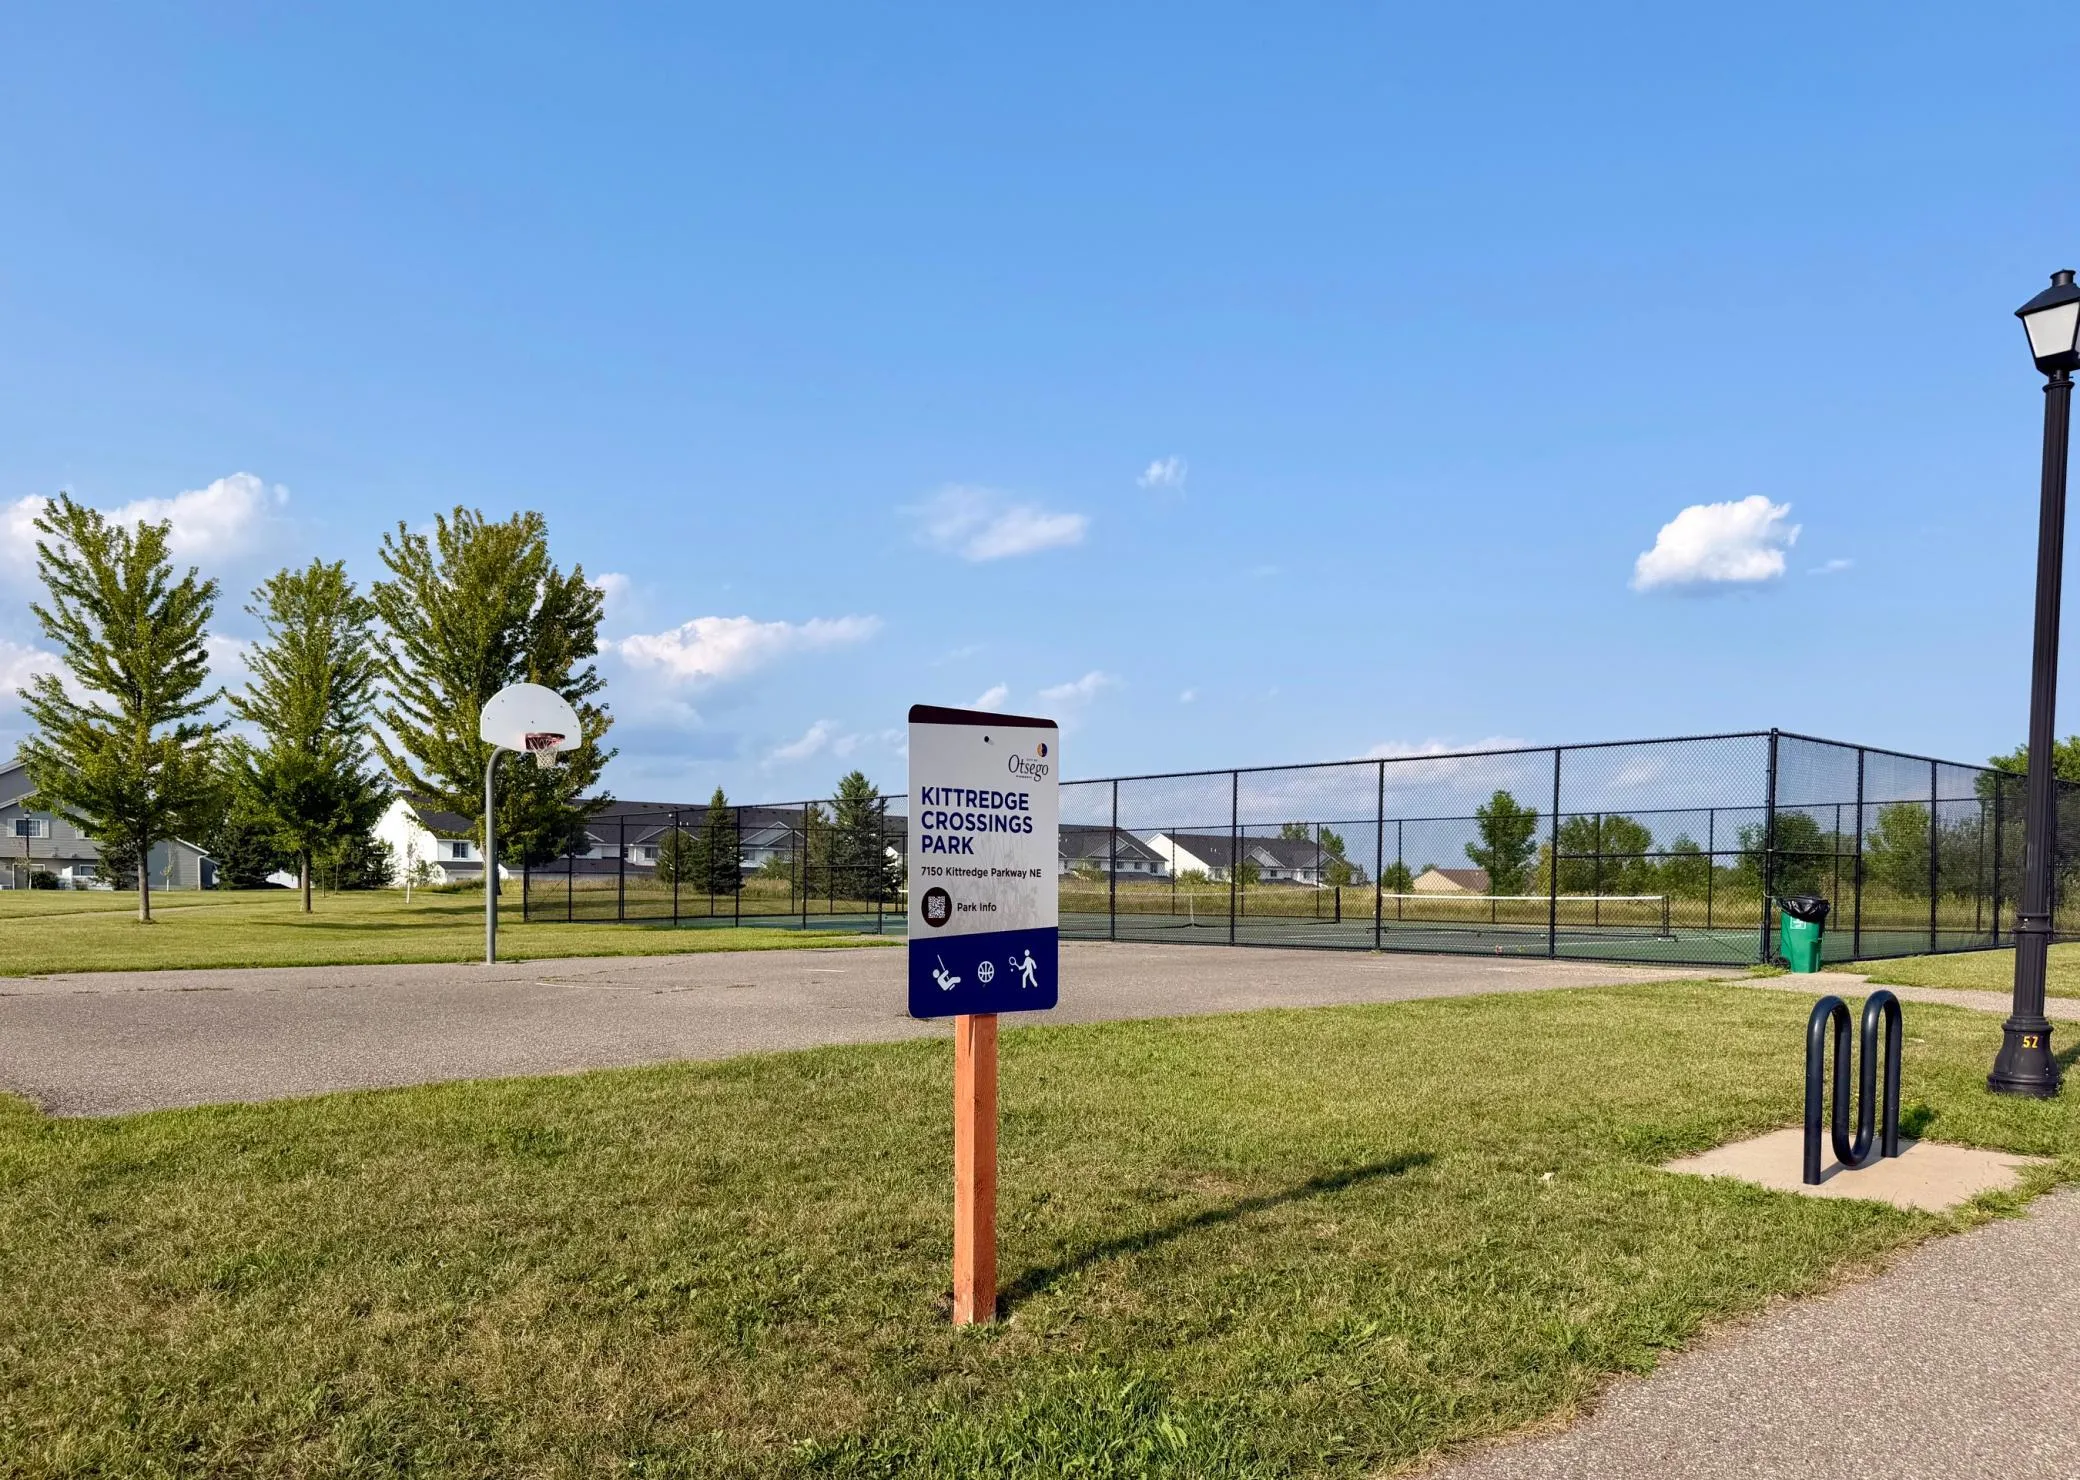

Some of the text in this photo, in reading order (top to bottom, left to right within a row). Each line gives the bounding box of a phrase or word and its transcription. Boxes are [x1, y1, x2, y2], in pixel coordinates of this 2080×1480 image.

[1008, 754, 1049, 782] Otsego
[921, 786, 1029, 811] KITTREDGE
[921, 810, 1033, 834] CROSSINGS
[921, 834, 974, 855] PARK
[921, 866, 1042, 879] 7150 Kittredge Parkway NE
[957, 902, 997, 912] Park Info
